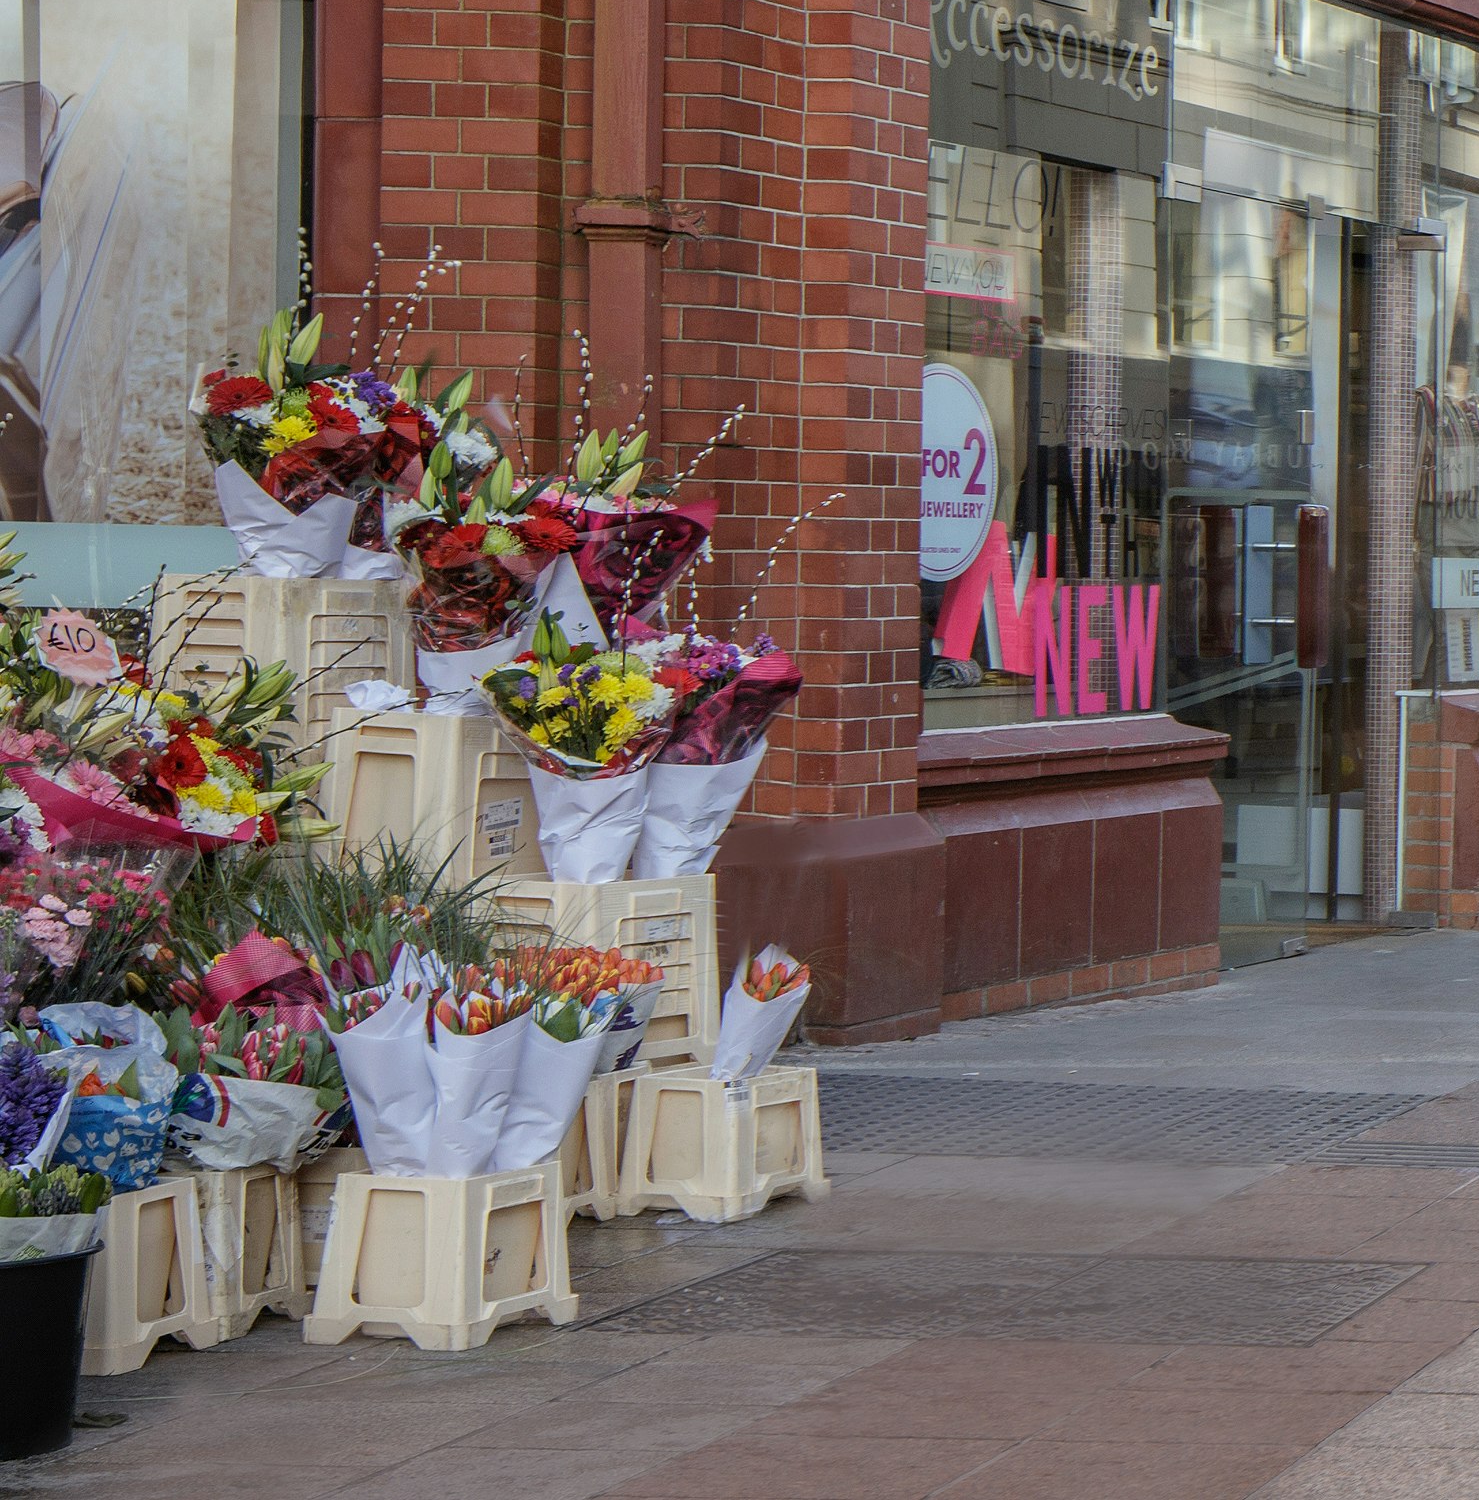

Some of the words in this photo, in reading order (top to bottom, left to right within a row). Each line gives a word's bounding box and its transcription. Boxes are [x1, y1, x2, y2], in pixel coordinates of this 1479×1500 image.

[921, 448, 961, 479] FOR
[963, 427, 987, 496] 2
[1034, 584, 1161, 718] NEW
